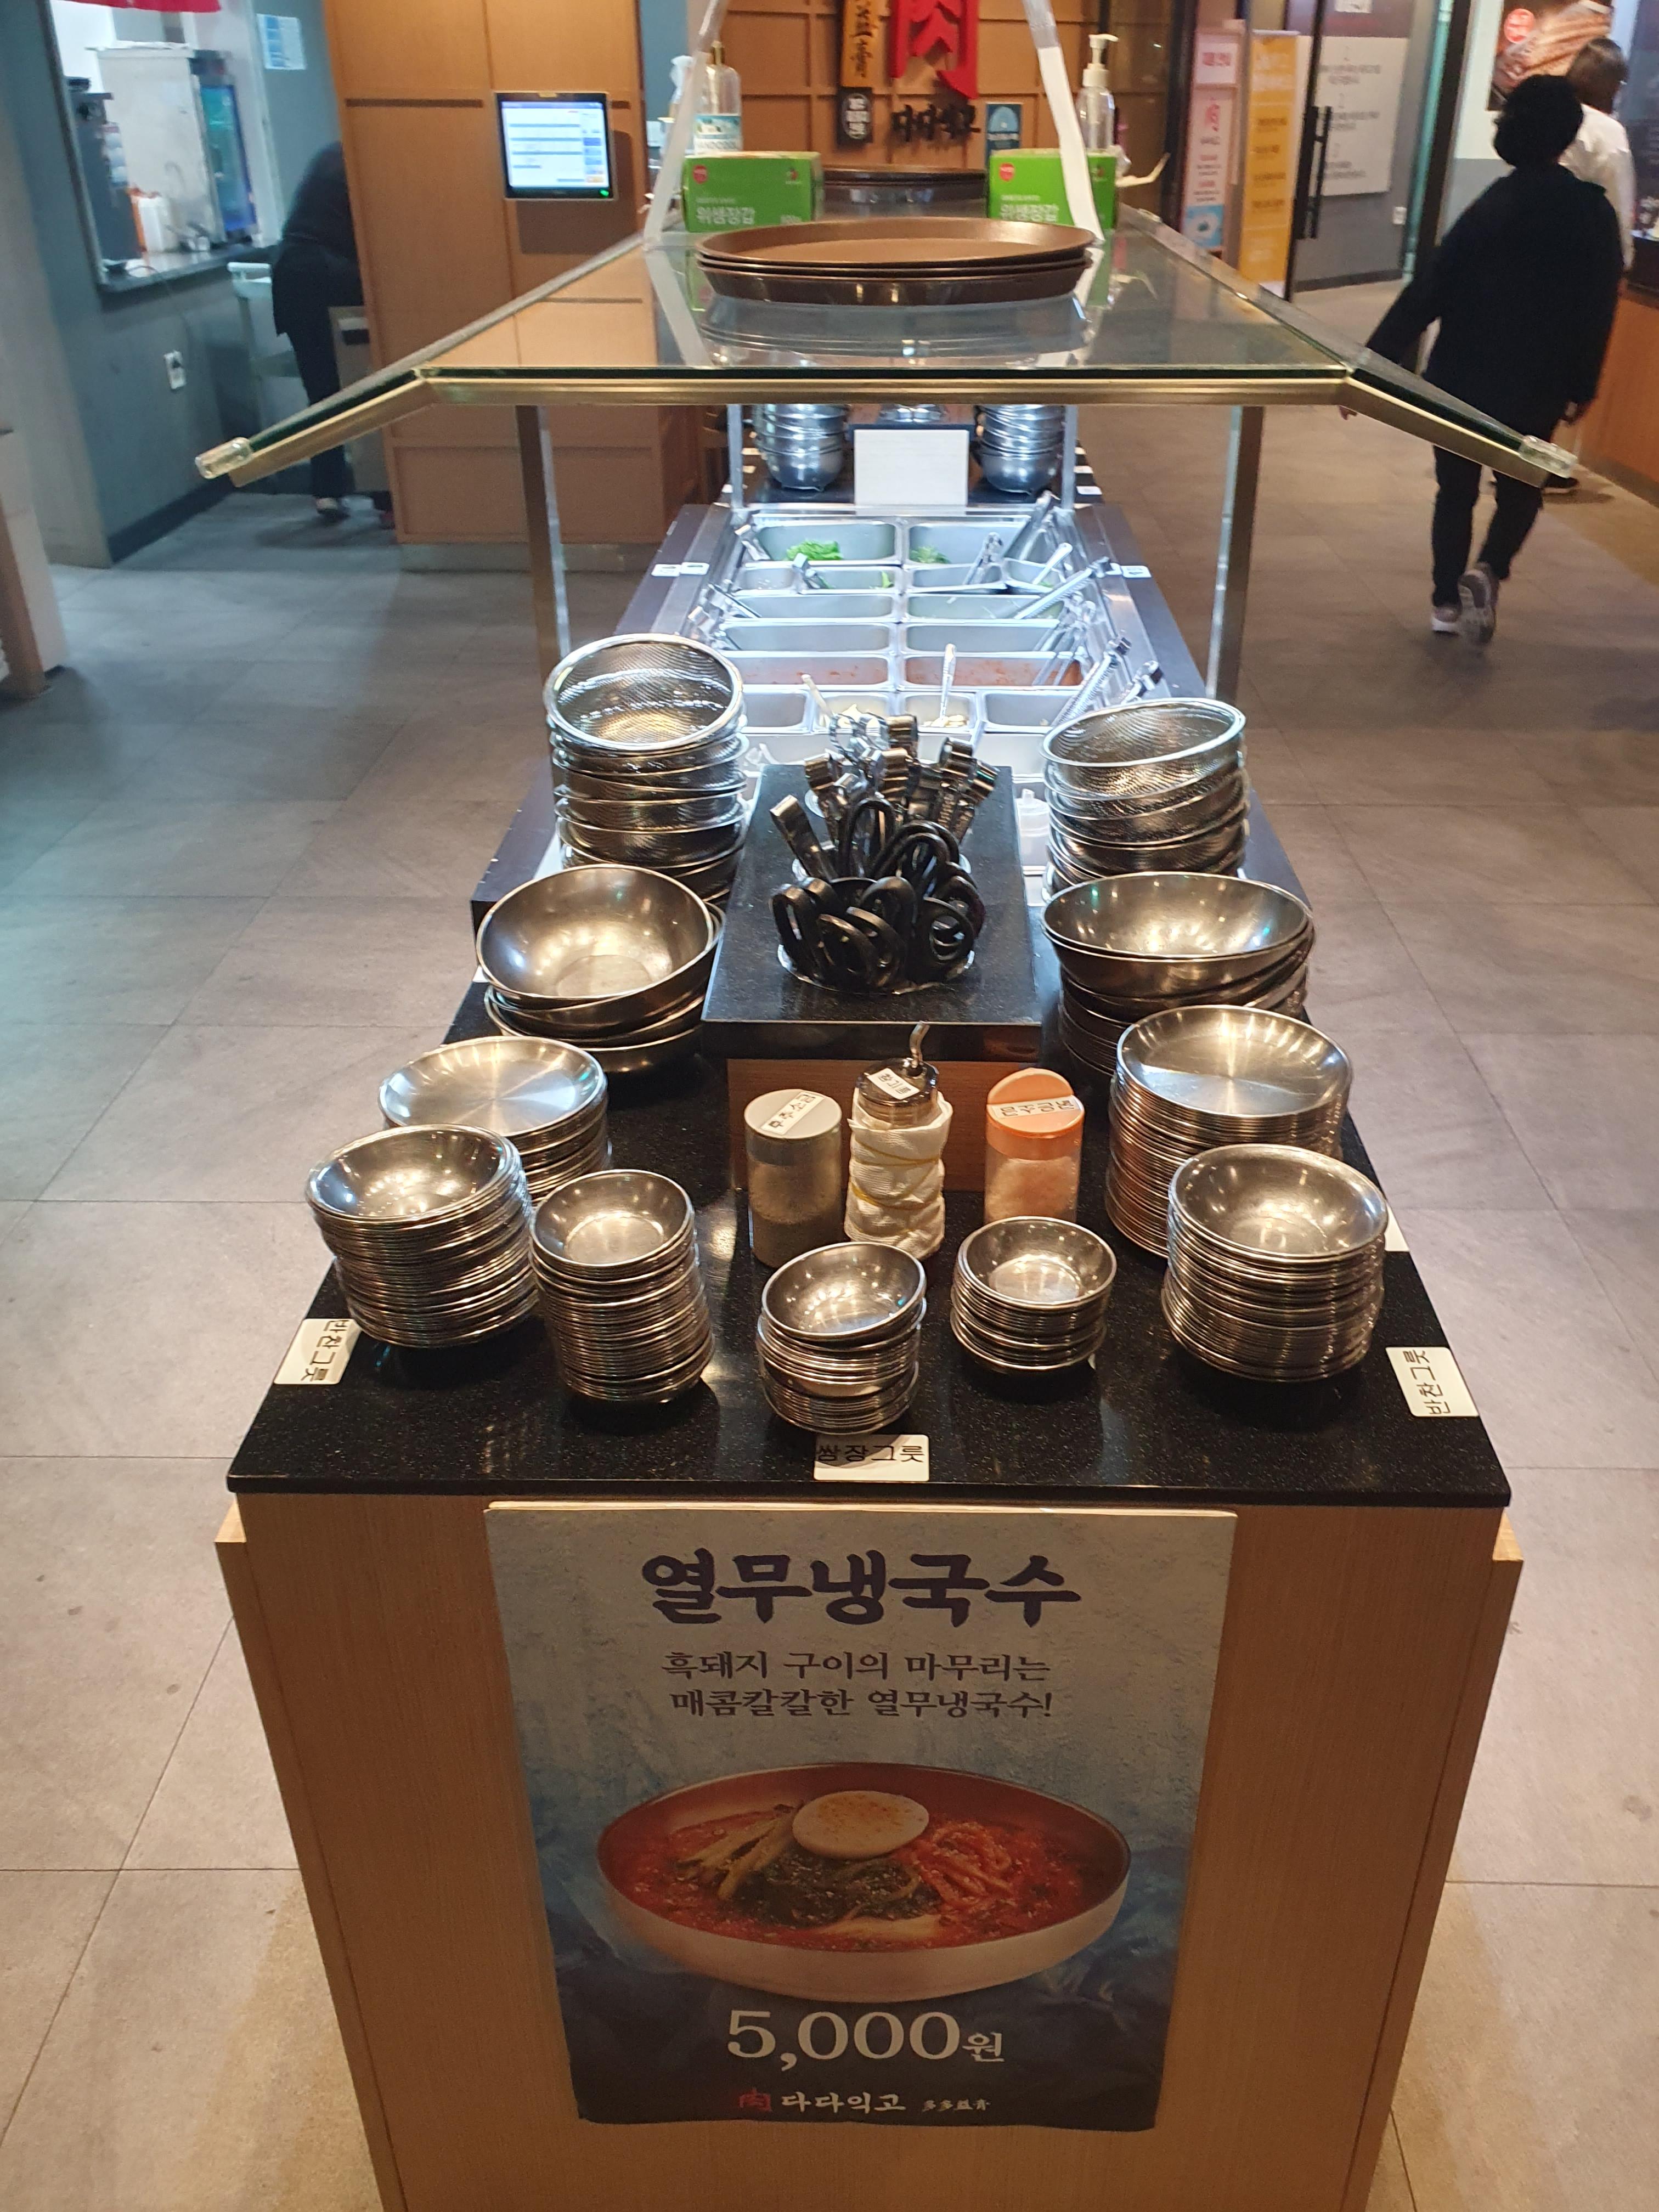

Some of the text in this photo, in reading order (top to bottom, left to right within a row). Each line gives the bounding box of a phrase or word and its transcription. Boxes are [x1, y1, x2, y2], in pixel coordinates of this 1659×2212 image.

[878, 1073, 912, 1094] 참기름
[301, 1319, 350, 1382] 반찬그릇
[1402, 1349, 1451, 1415] 반찬그릇
[817, 1444, 925, 1463] 쌈장그릇
[641, 1548, 1082, 1628] 열무냉국수
[661, 1650, 1051, 1681] 흑돼지 구이의 마무리는
[669, 1688, 1053, 1719] 매콤칼칼한 열무냉국수!
[727, 2009, 1005, 2072] 5,000원
